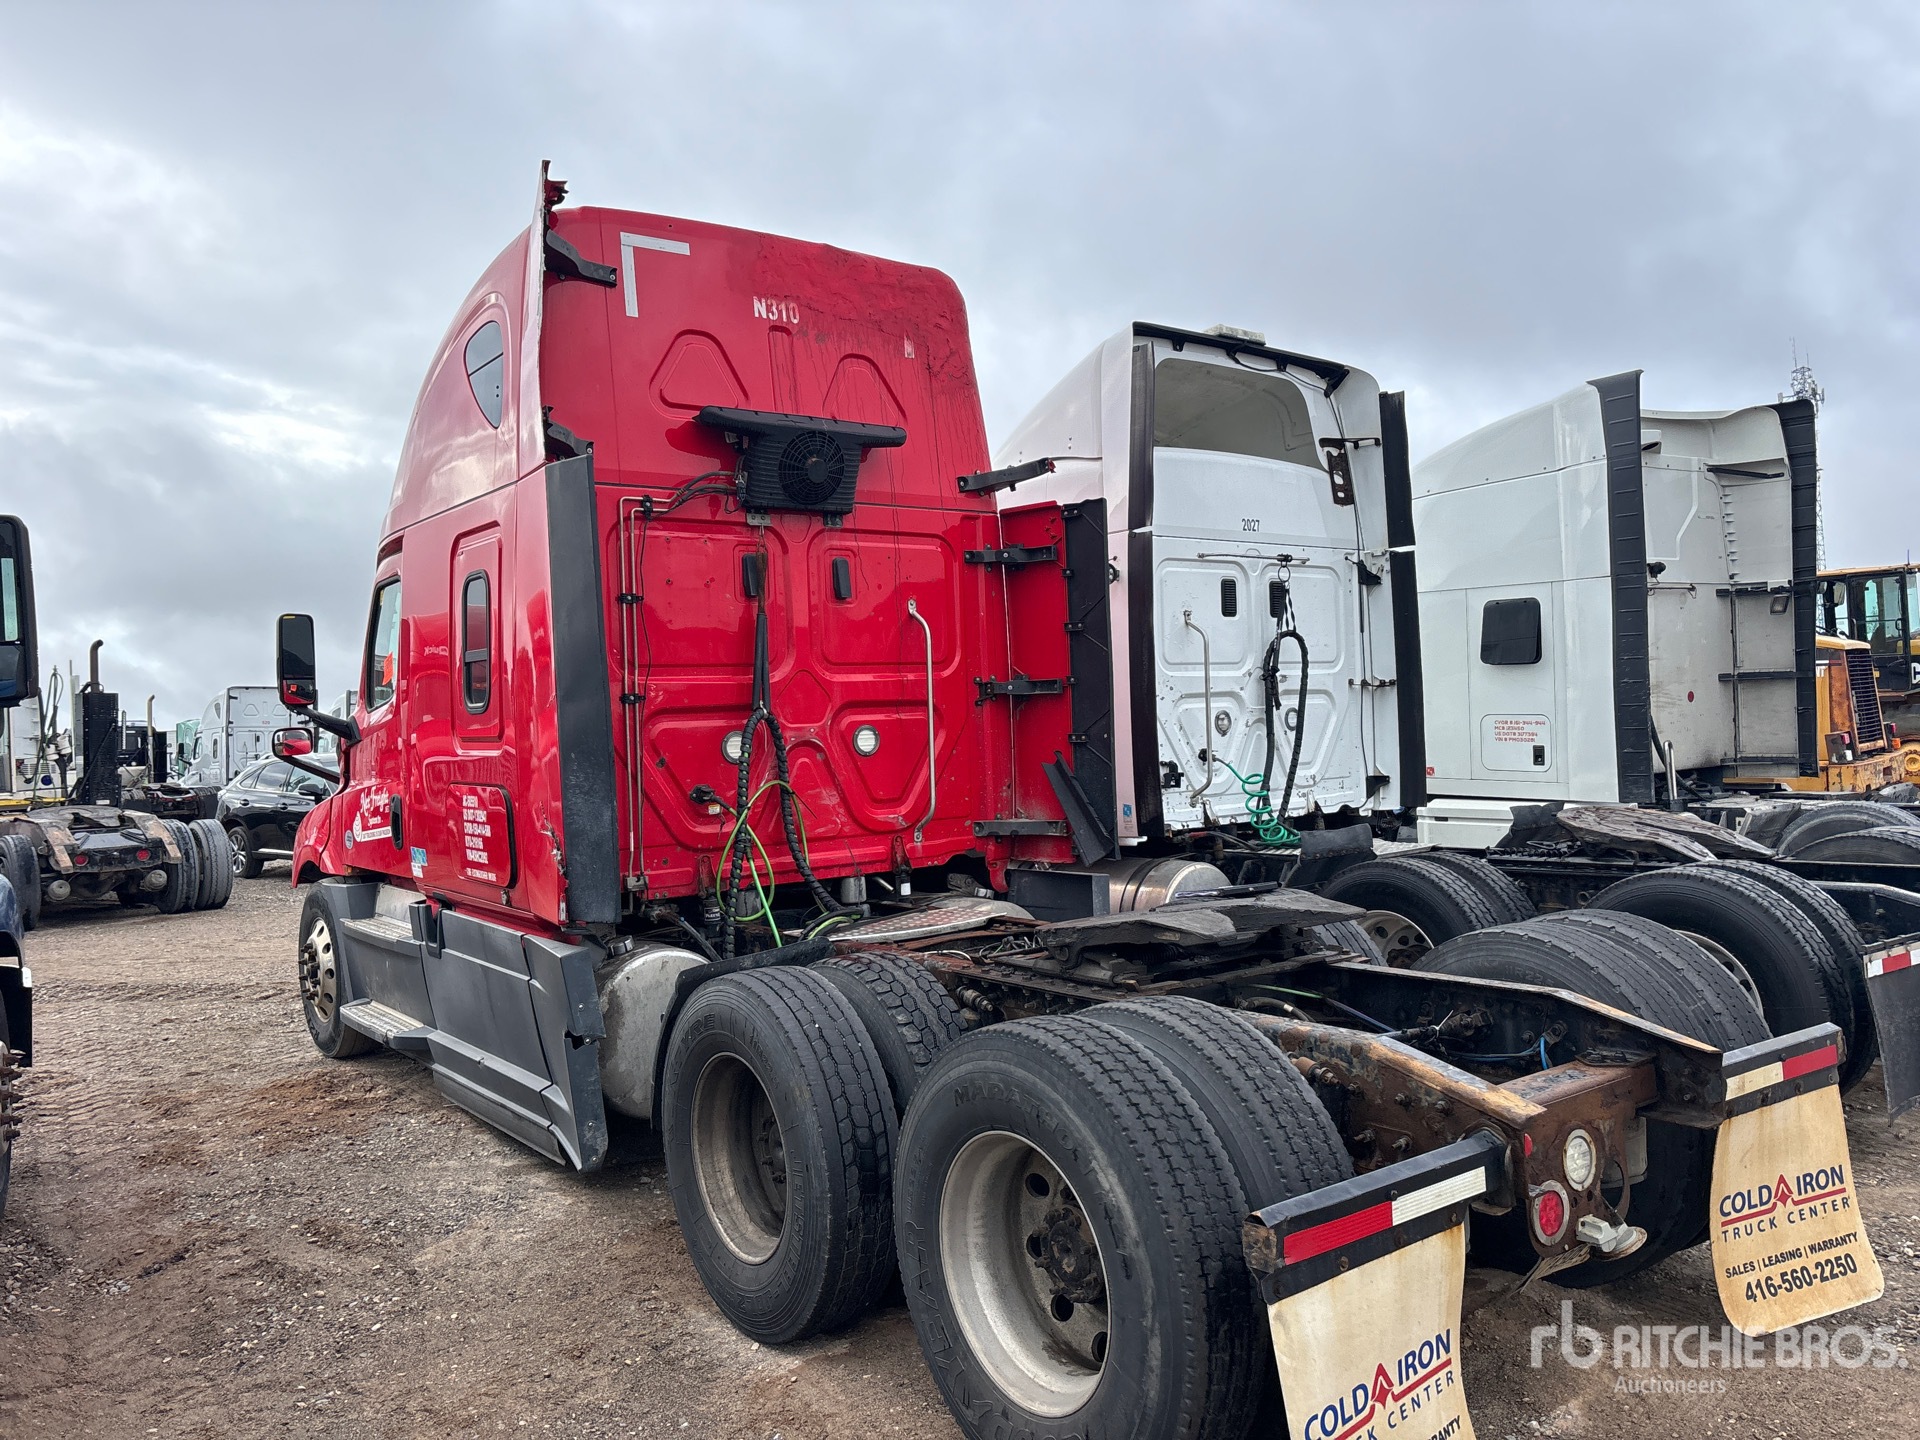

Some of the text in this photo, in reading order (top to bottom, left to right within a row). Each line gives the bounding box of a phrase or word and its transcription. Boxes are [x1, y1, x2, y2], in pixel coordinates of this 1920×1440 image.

[753, 296, 800, 324] N310
[1241, 518, 1260, 532] 2027
[1719, 1164, 1845, 1218] COLD IRON
[1721, 1196, 1850, 1243] TRUCK CENTER
[1725, 1260, 1756, 1279] SALES
[1762, 1248, 1803, 1268] LEASING
[1808, 1232, 1858, 1255] WARRANTY
[1745, 1253, 1858, 1303] 416-560-2250
[1304, 1328, 1451, 1440] COLD IRON
[1387, 1370, 1454, 1429] CENTER
